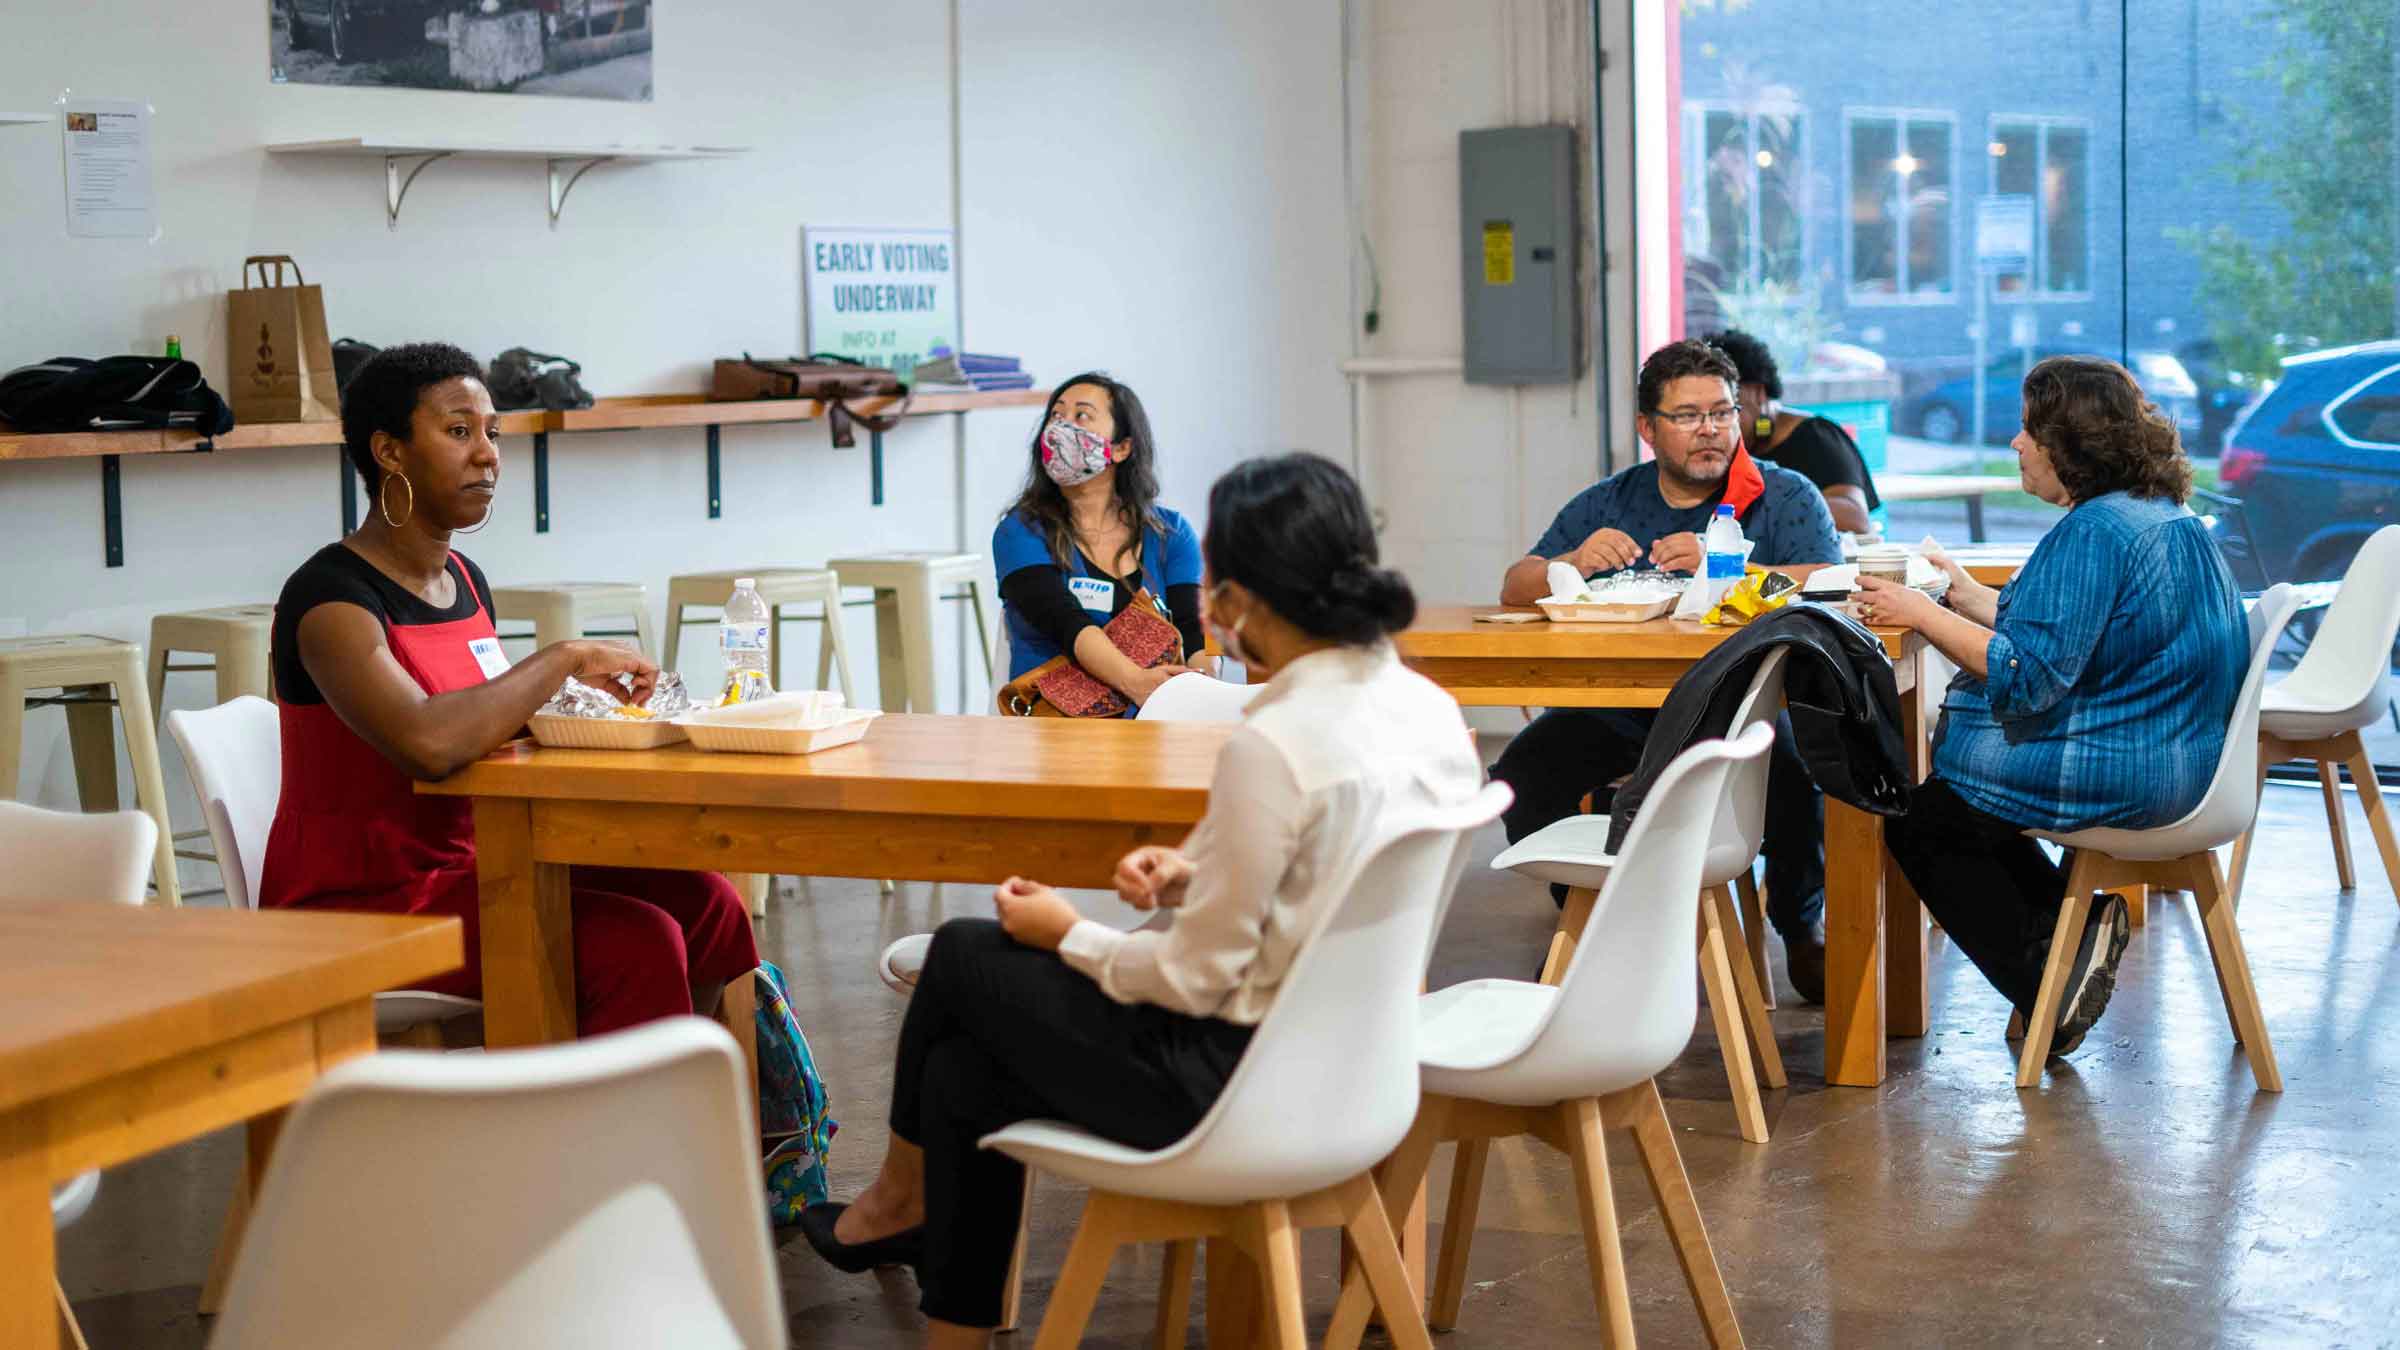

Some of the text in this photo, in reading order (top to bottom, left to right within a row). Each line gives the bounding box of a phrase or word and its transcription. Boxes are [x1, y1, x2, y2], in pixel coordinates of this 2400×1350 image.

[816, 242, 949, 272] EARLY VOTING
[834, 284, 937, 313] UNDERWAY
[841, 329, 896, 348] INFO AT
